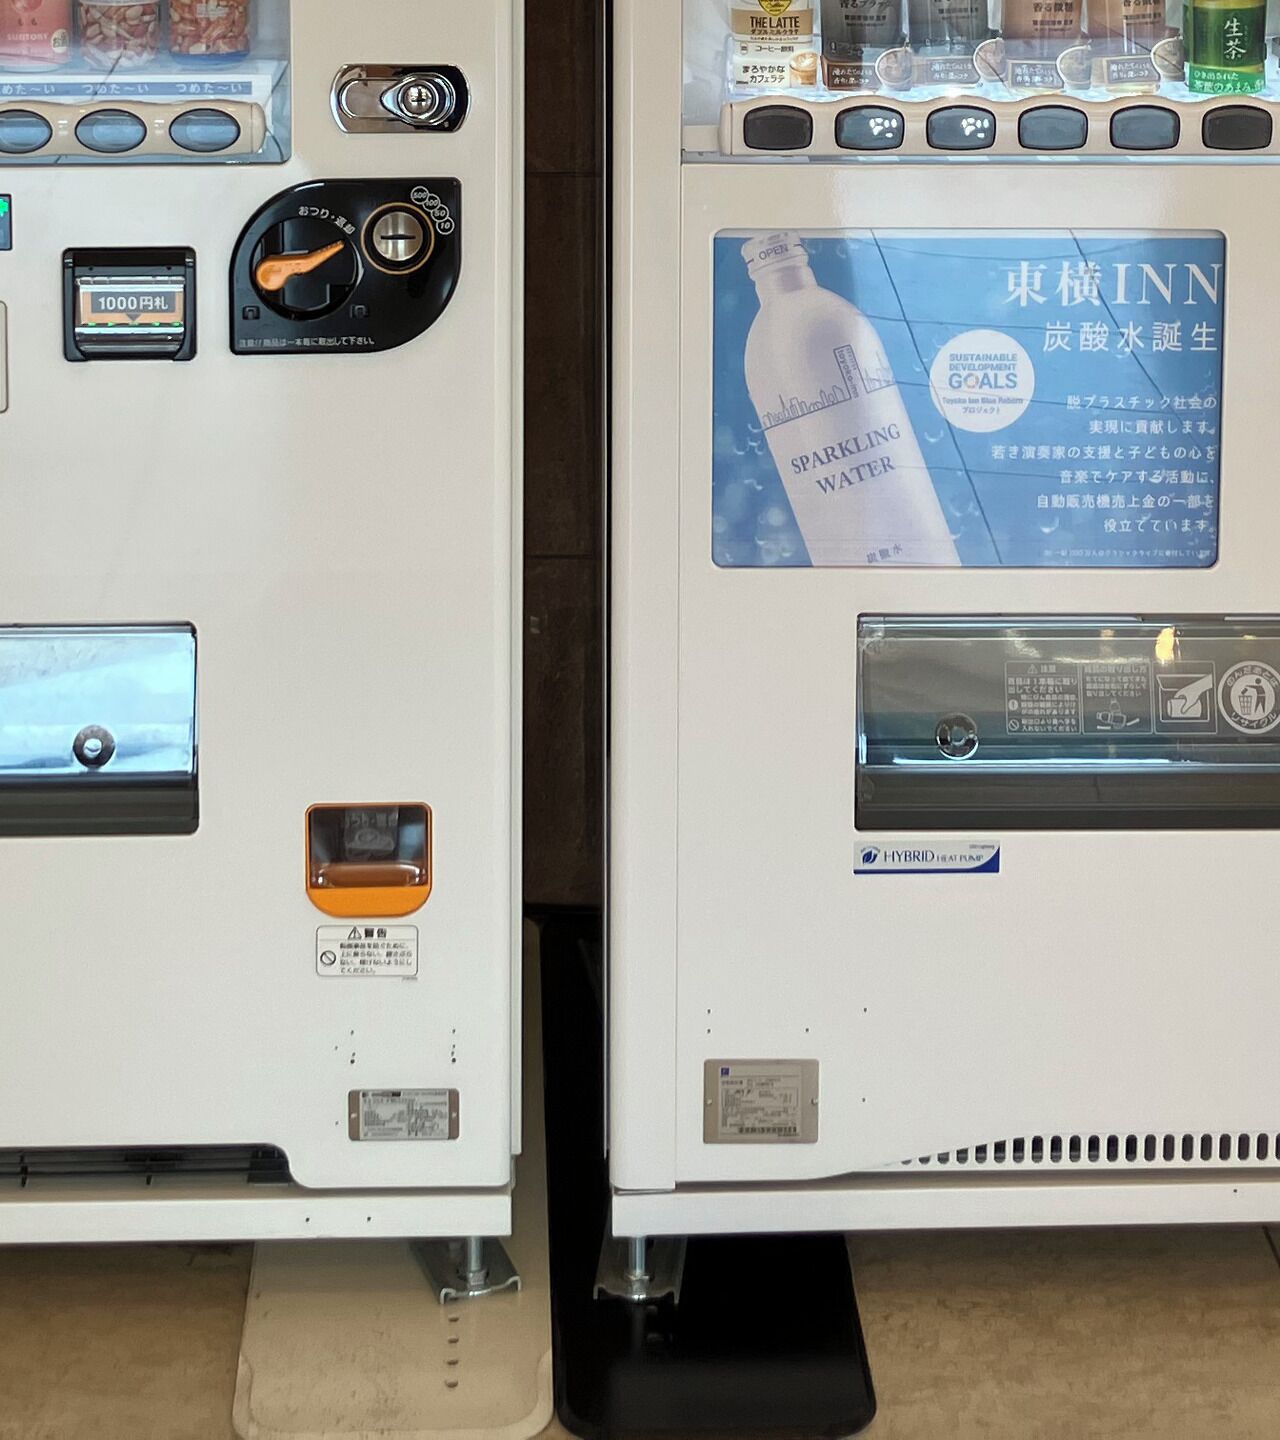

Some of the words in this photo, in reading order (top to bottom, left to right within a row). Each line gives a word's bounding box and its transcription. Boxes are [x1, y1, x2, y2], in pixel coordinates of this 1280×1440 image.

[750, 16, 767, 28] THE
[770, 16, 801, 28] LATTE
[1223, 17, 1247, 60] 生茶
[742, 65, 786, 73] まろやかな
[749, 74, 785, 84] カフェラテ
[440, 222, 451, 230] 10
[758, 243, 790, 262] OPEN
[1002, 261, 1222, 308] 東横INN
[98, 296, 169, 310] 1000円札
[1042, 320, 1219, 353] 炭酸水誕生
[949, 353, 1018, 362] SUSTAINABLE
[949, 363, 1017, 372] DEVELOPMENT
[948, 372, 1018, 390] GOALS
[1067, 396, 1217, 409] 脱プラスチック社会の
[1089, 420, 1216, 434] 実現に貢献します。
[789, 423, 901, 475] SPARKLING
[991, 445, 1217, 460] 若き演奏家の支援と子どもの心を
[814, 456, 896, 495] WATER
[1060, 470, 1215, 484] 音楽でケアする活動に、
[1037, 494, 1214, 509] 自動販売機売上金の一部を
[1104, 518, 1216, 533] 役立てています。
[1230, 711, 1279, 731] リサイクル
[883, 849, 935, 863] HYBRID
